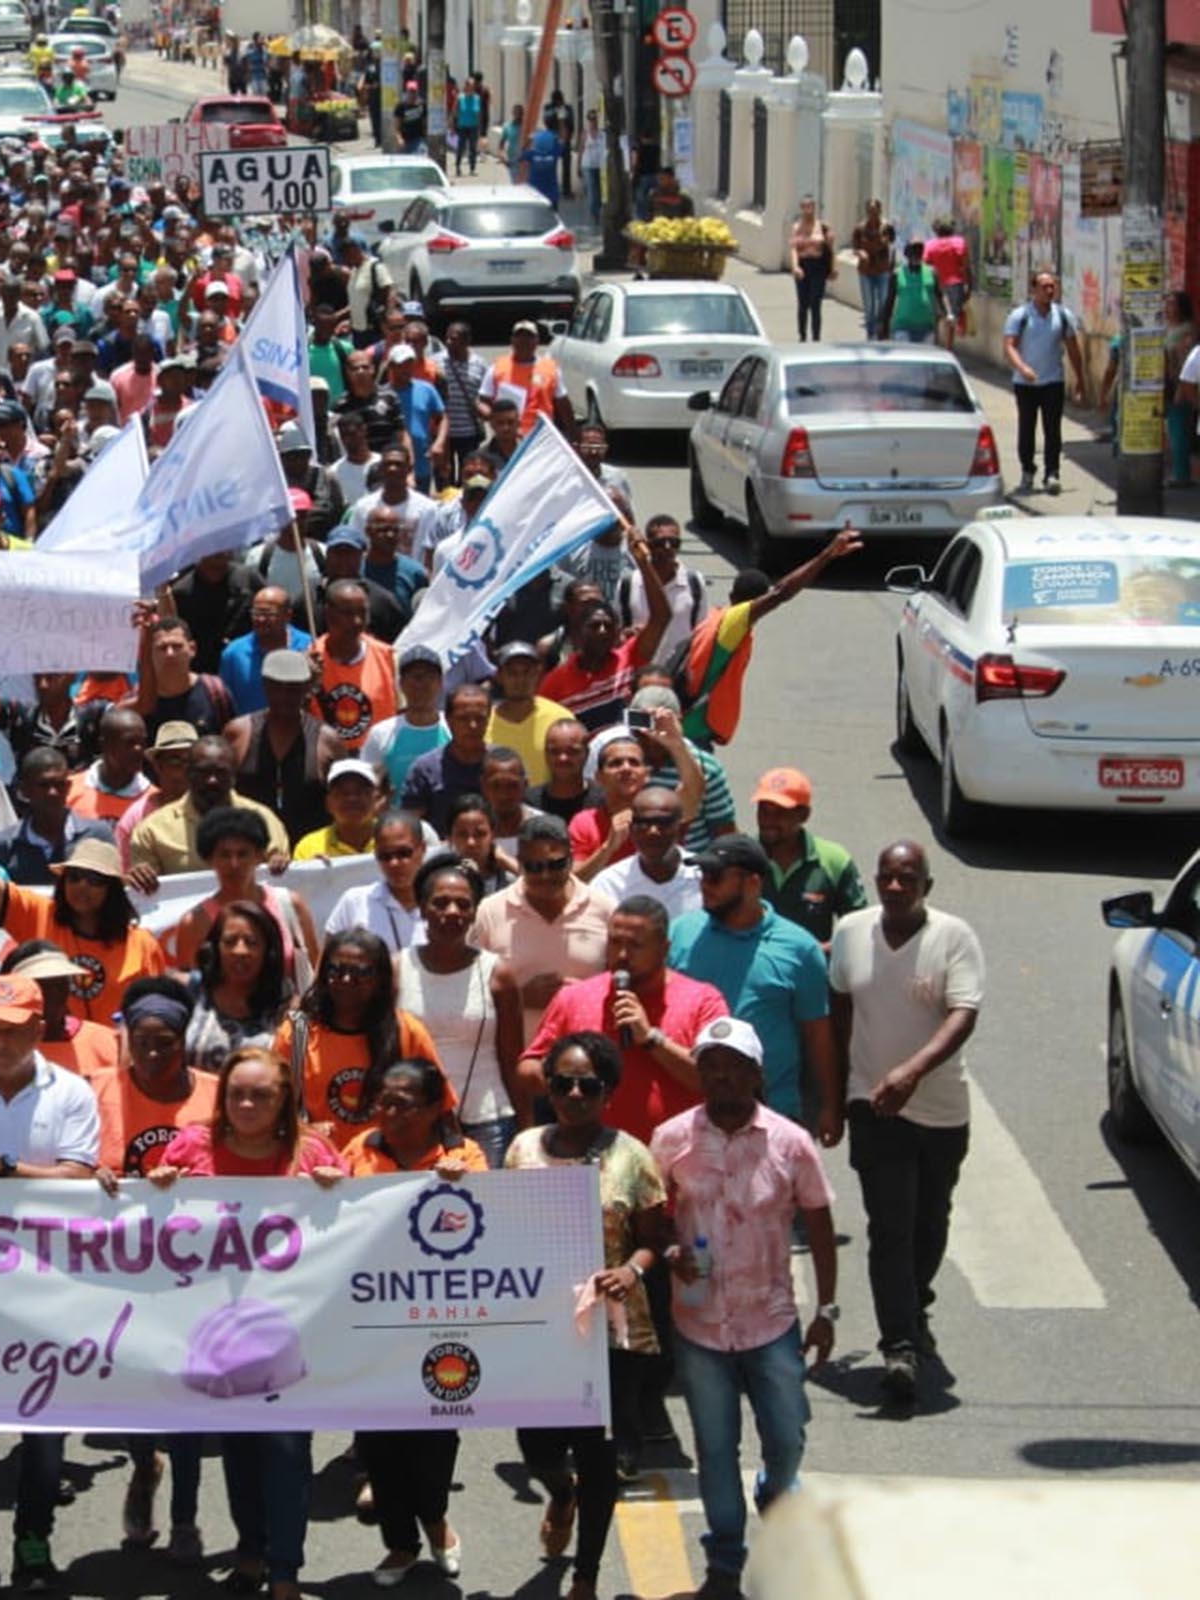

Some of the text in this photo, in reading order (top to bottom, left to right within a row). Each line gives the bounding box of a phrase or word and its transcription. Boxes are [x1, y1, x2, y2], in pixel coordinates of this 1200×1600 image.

[208, 153, 324, 185] AGUA
[261, 180, 318, 213] 1,00
[351, 1266, 544, 1303] SINTEPAV
[409, 1306, 488, 1320] BAHIA
[430, 1404, 475, 1417] BAHIA
